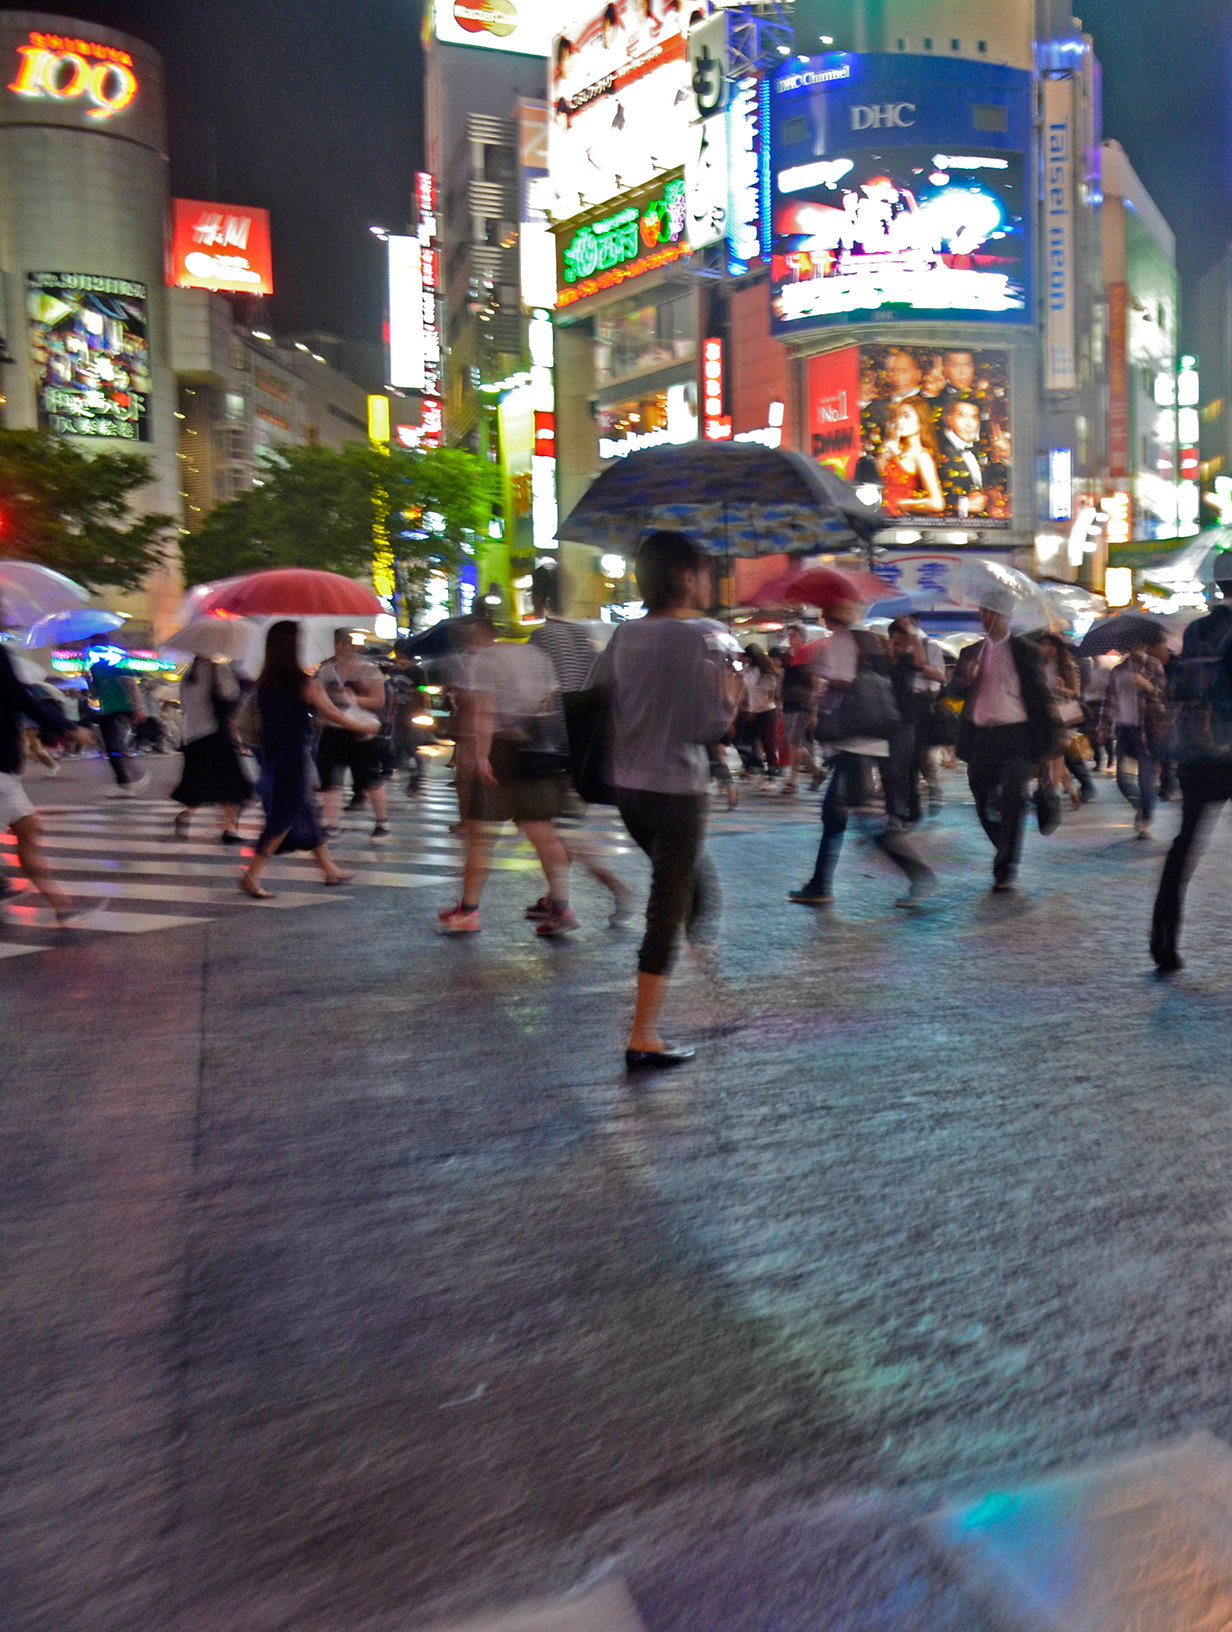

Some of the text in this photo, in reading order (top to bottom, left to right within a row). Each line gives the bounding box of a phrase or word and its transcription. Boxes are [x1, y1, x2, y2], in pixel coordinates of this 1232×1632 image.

[7, 45, 139, 118] 109
[776, 65, 850, 94] DHC Channel
[851, 102, 916, 131] DHC
[191, 212, 252, 250] H&M
[1050, 226, 1066, 311] neon
